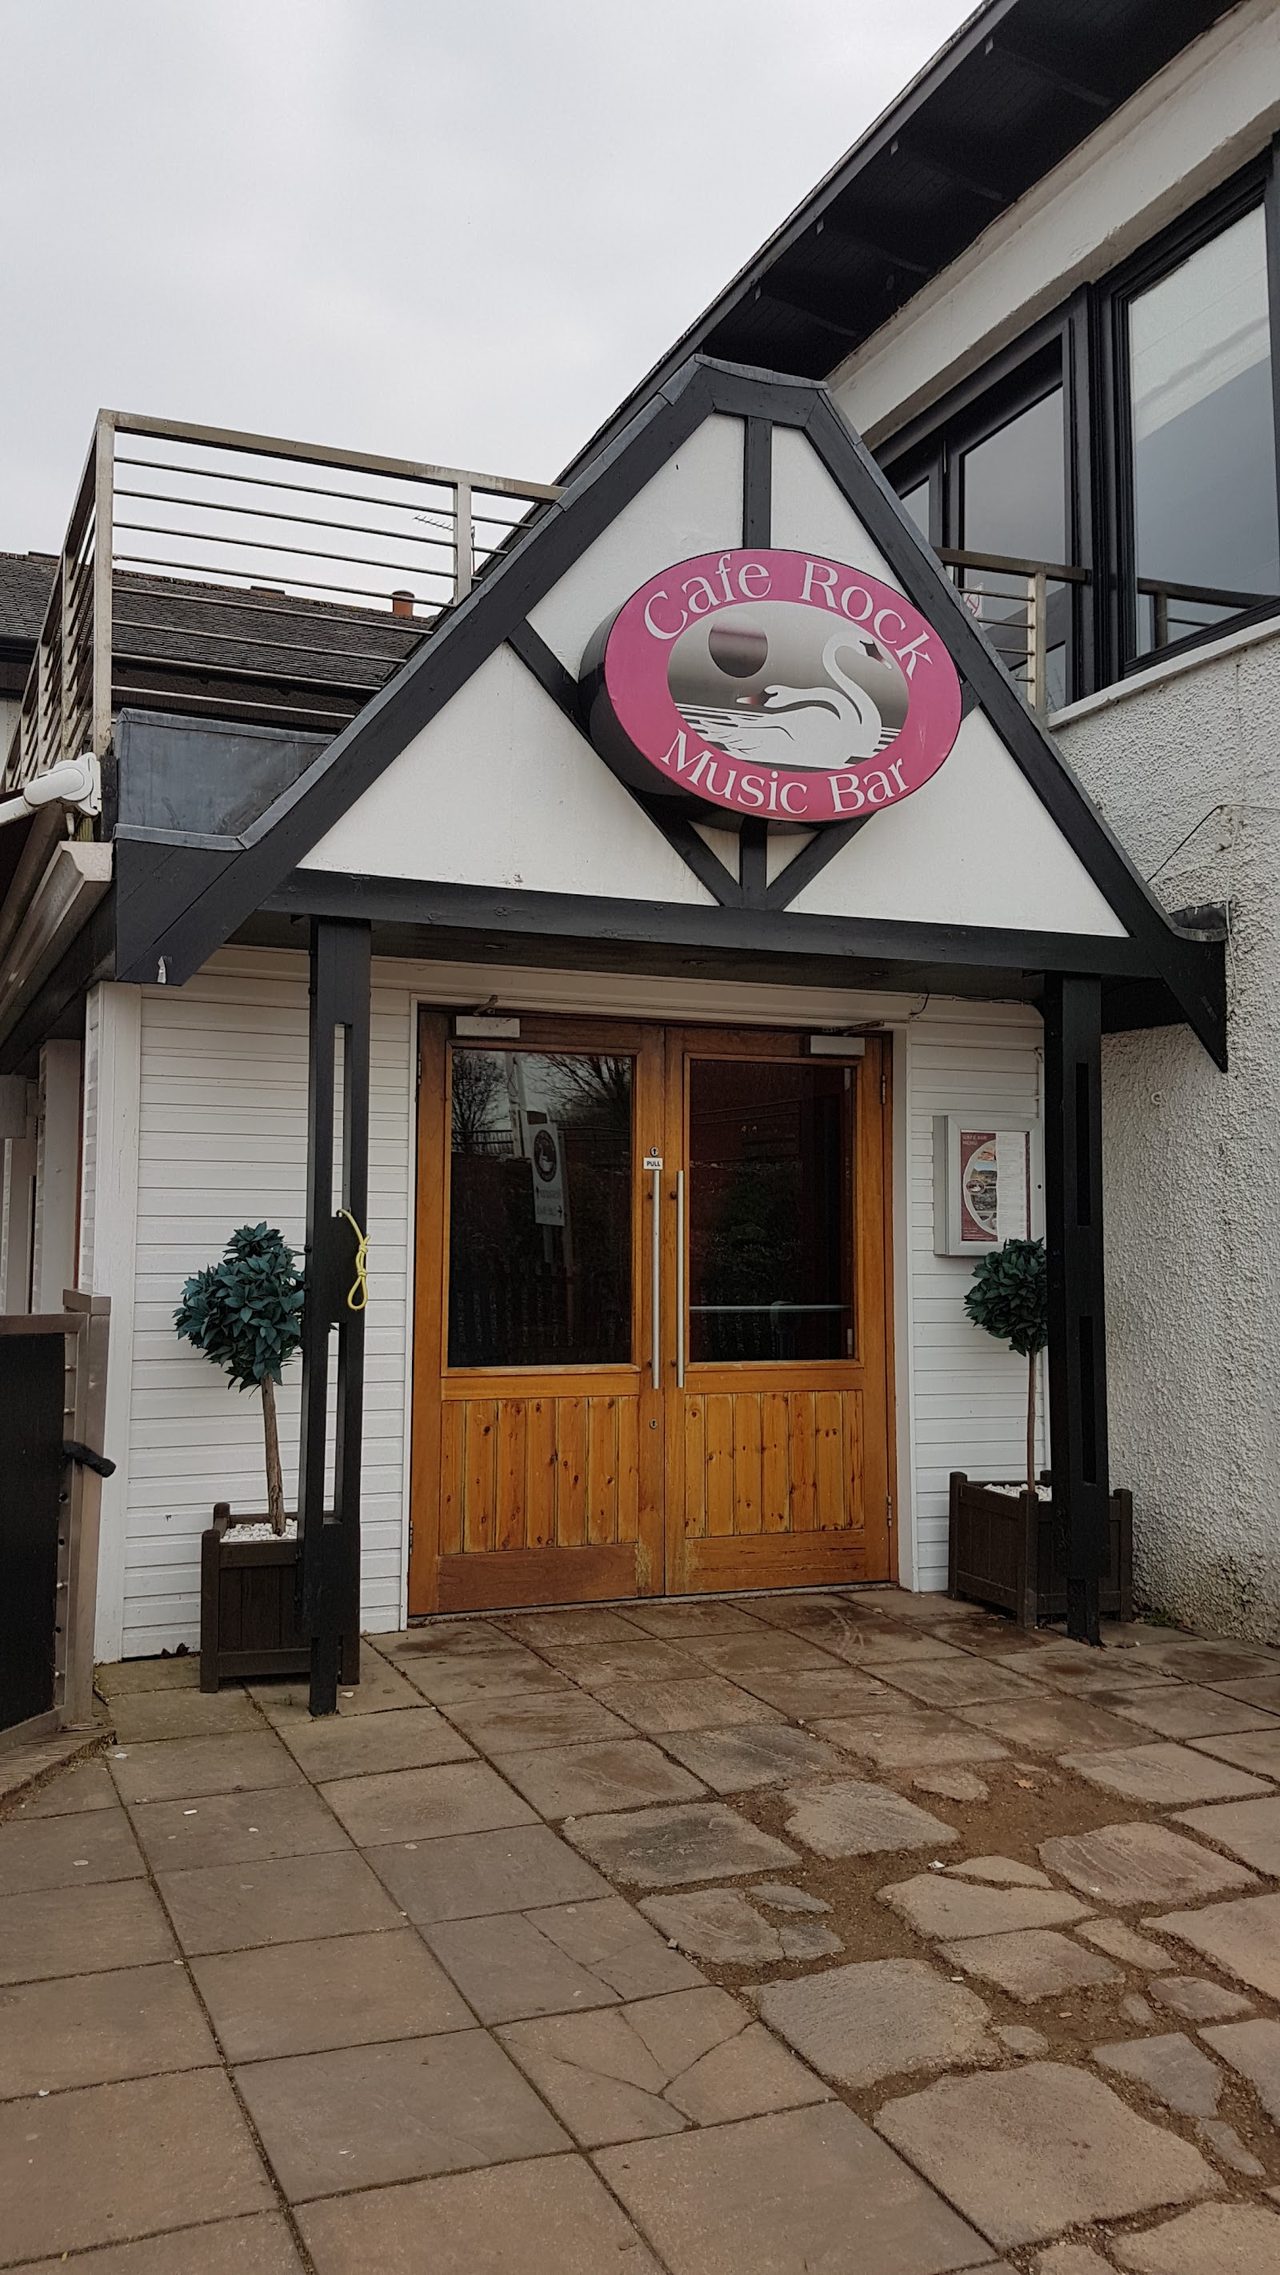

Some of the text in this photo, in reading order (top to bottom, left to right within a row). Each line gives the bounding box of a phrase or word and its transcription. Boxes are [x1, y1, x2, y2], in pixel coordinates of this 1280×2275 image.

[643, 554, 933, 680] Cafe Rock
[660, 729, 910, 815] Music Bar
